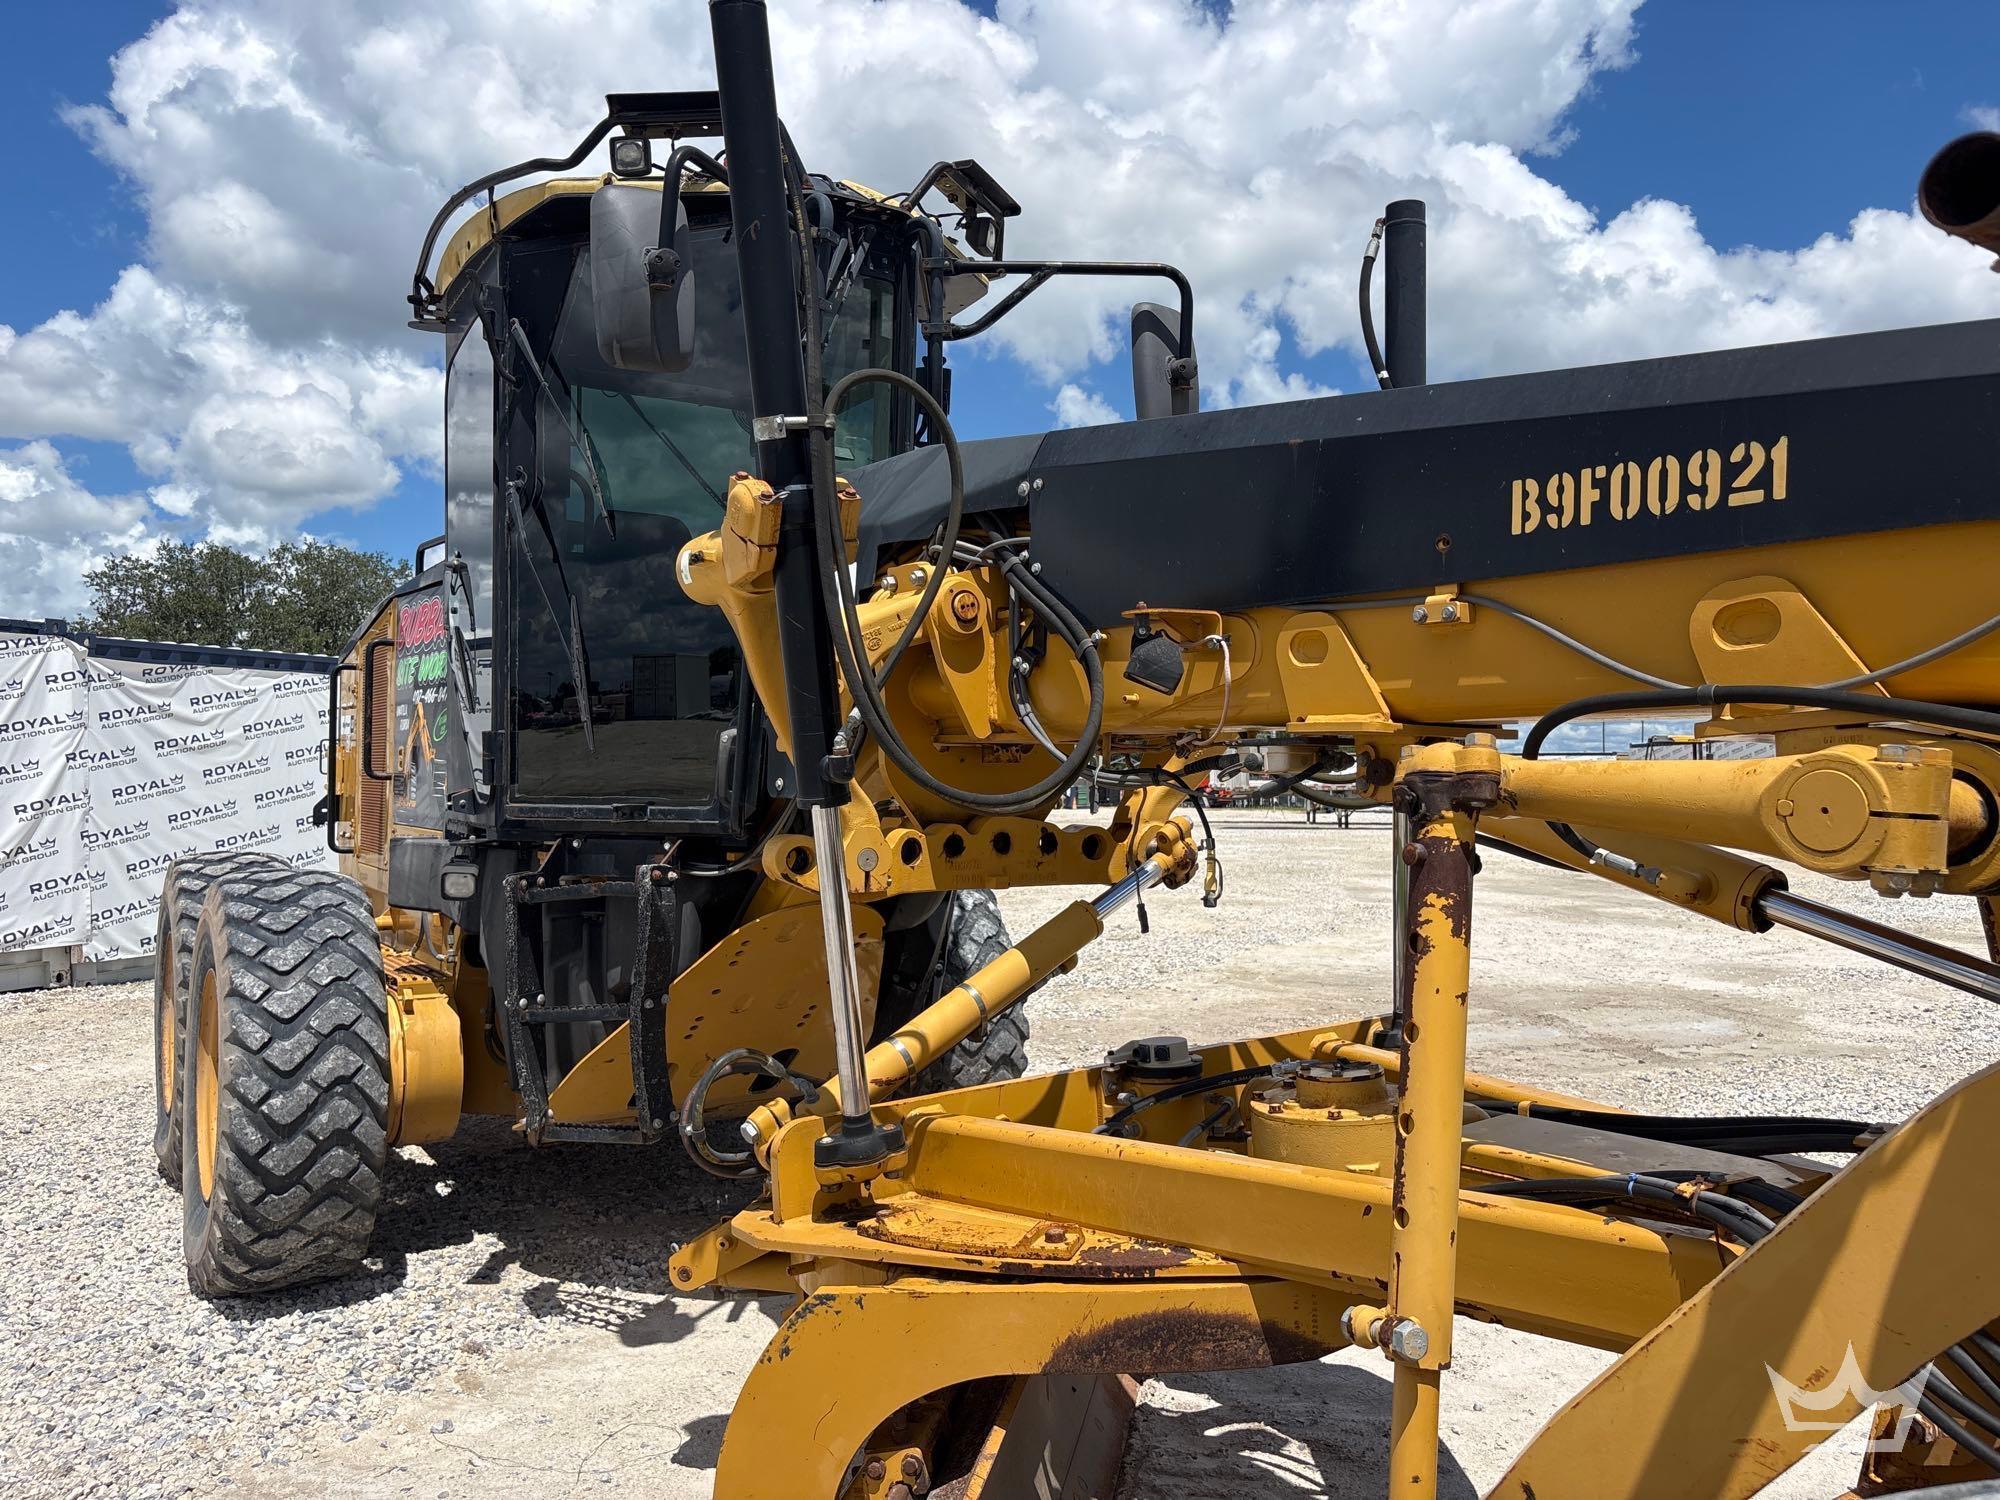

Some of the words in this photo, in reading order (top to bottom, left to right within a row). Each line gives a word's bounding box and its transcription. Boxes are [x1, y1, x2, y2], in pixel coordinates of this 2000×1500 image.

[1511, 436, 1788, 535] B9F00921
[32, 644, 69, 655] GROUP
[45, 669, 107, 685] ROYAL
[145, 674, 183, 684] AUCTION
[185, 669, 214, 679] GROUP
[273, 677, 319, 693] ROYAL
[93, 682, 125, 692] GROUP
[275, 689, 308, 700] AUCTION
[308, 685, 330, 695] GROU
[190, 690, 244, 707] ROYAL
[193, 703, 230, 714] AUCTION
[231, 697, 259, 708] GROUP
[99, 705, 157, 722] ROYAL
[101, 718, 141, 730] AUCTION
[143, 712, 174, 722] GROUP
[0, 714, 66, 734] ROYAL
[0, 730, 46, 742] AUCTION
[48, 721, 86, 734] GROUP
[243, 717, 291, 734] ROYAL
[245, 729, 279, 741] AUCTION
[280, 724, 305, 734] GROUP
[154, 733, 211, 751] ROYAL
[157, 747, 195, 759] AUCTION
[197, 740, 227, 750] GROUP
[106, 758, 137, 769] GROUP
[203, 760, 256, 778] ROYAL
[287, 756, 319, 767] AUCTION
[6, 771, 43, 784] GROUP
[205, 773, 242, 786] AUCTION
[244, 766, 271, 777] GROUP
[112, 779, 170, 799] ROYAL
[115, 793, 154, 806] AUCTION
[156, 786, 186, 797] GROUP
[254, 784, 303, 803] ROYAL
[14, 793, 82, 815] ROYAL
[256, 797, 290, 810] AUCTION
[291, 790, 316, 801] GROUP
[18, 808, 64, 823] AUCTION
[168, 804, 222, 824] ROYAL
[170, 817, 208, 831] AUCTION
[210, 810, 239, 822] GROUP
[120, 832, 151, 844] GROUP
[215, 829, 268, 849] ROYAL
[255, 834, 282, 846] GROUP
[22, 850, 59, 864] GROUP
[287, 851, 313, 864] YAL
[301, 856, 326, 868] GROUP
[128, 866, 167, 881] AUCTION
[32, 884, 79, 903] AUCTION
[91, 900, 148, 924] ROYAL
[91, 914, 133, 931] AUCTION
[134, 907, 159, 920] GROU
[0, 922, 55, 945] OYAL
[39, 927, 75, 942] GROUP
